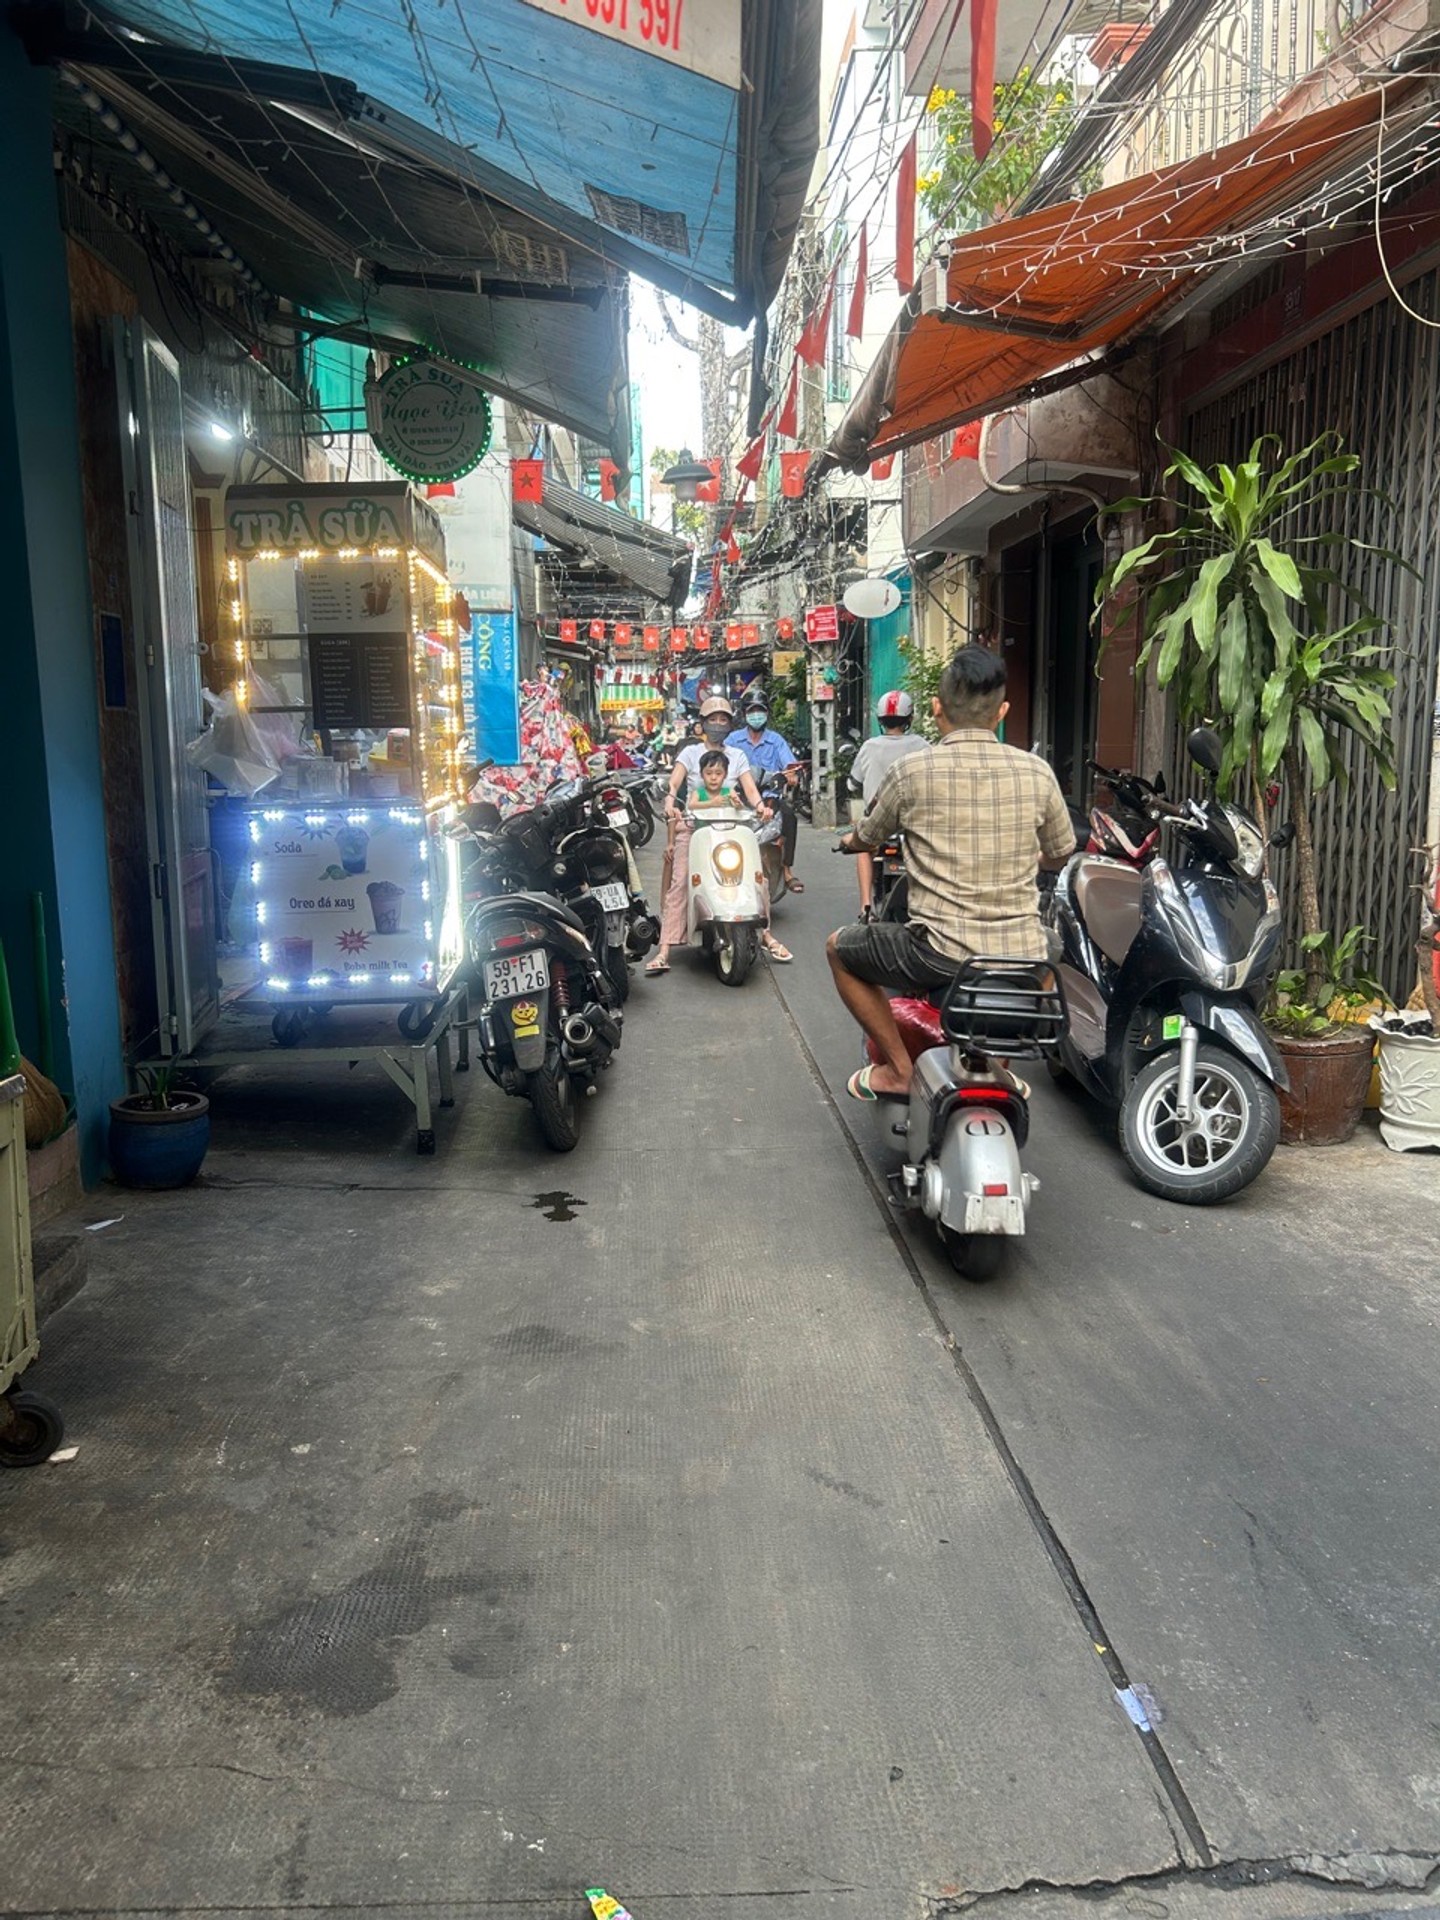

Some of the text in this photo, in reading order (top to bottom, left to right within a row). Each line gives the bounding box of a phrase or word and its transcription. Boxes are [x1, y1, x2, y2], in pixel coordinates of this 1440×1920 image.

[231, 500, 403, 549] TRÀ SỮA
[274, 841, 302, 853] Soda
[289, 896, 355, 910] Oreo đá xay
[369, 959, 391, 971] milk
[393, 960, 408, 969] Tea
[490, 970, 545, 998] 231.26
